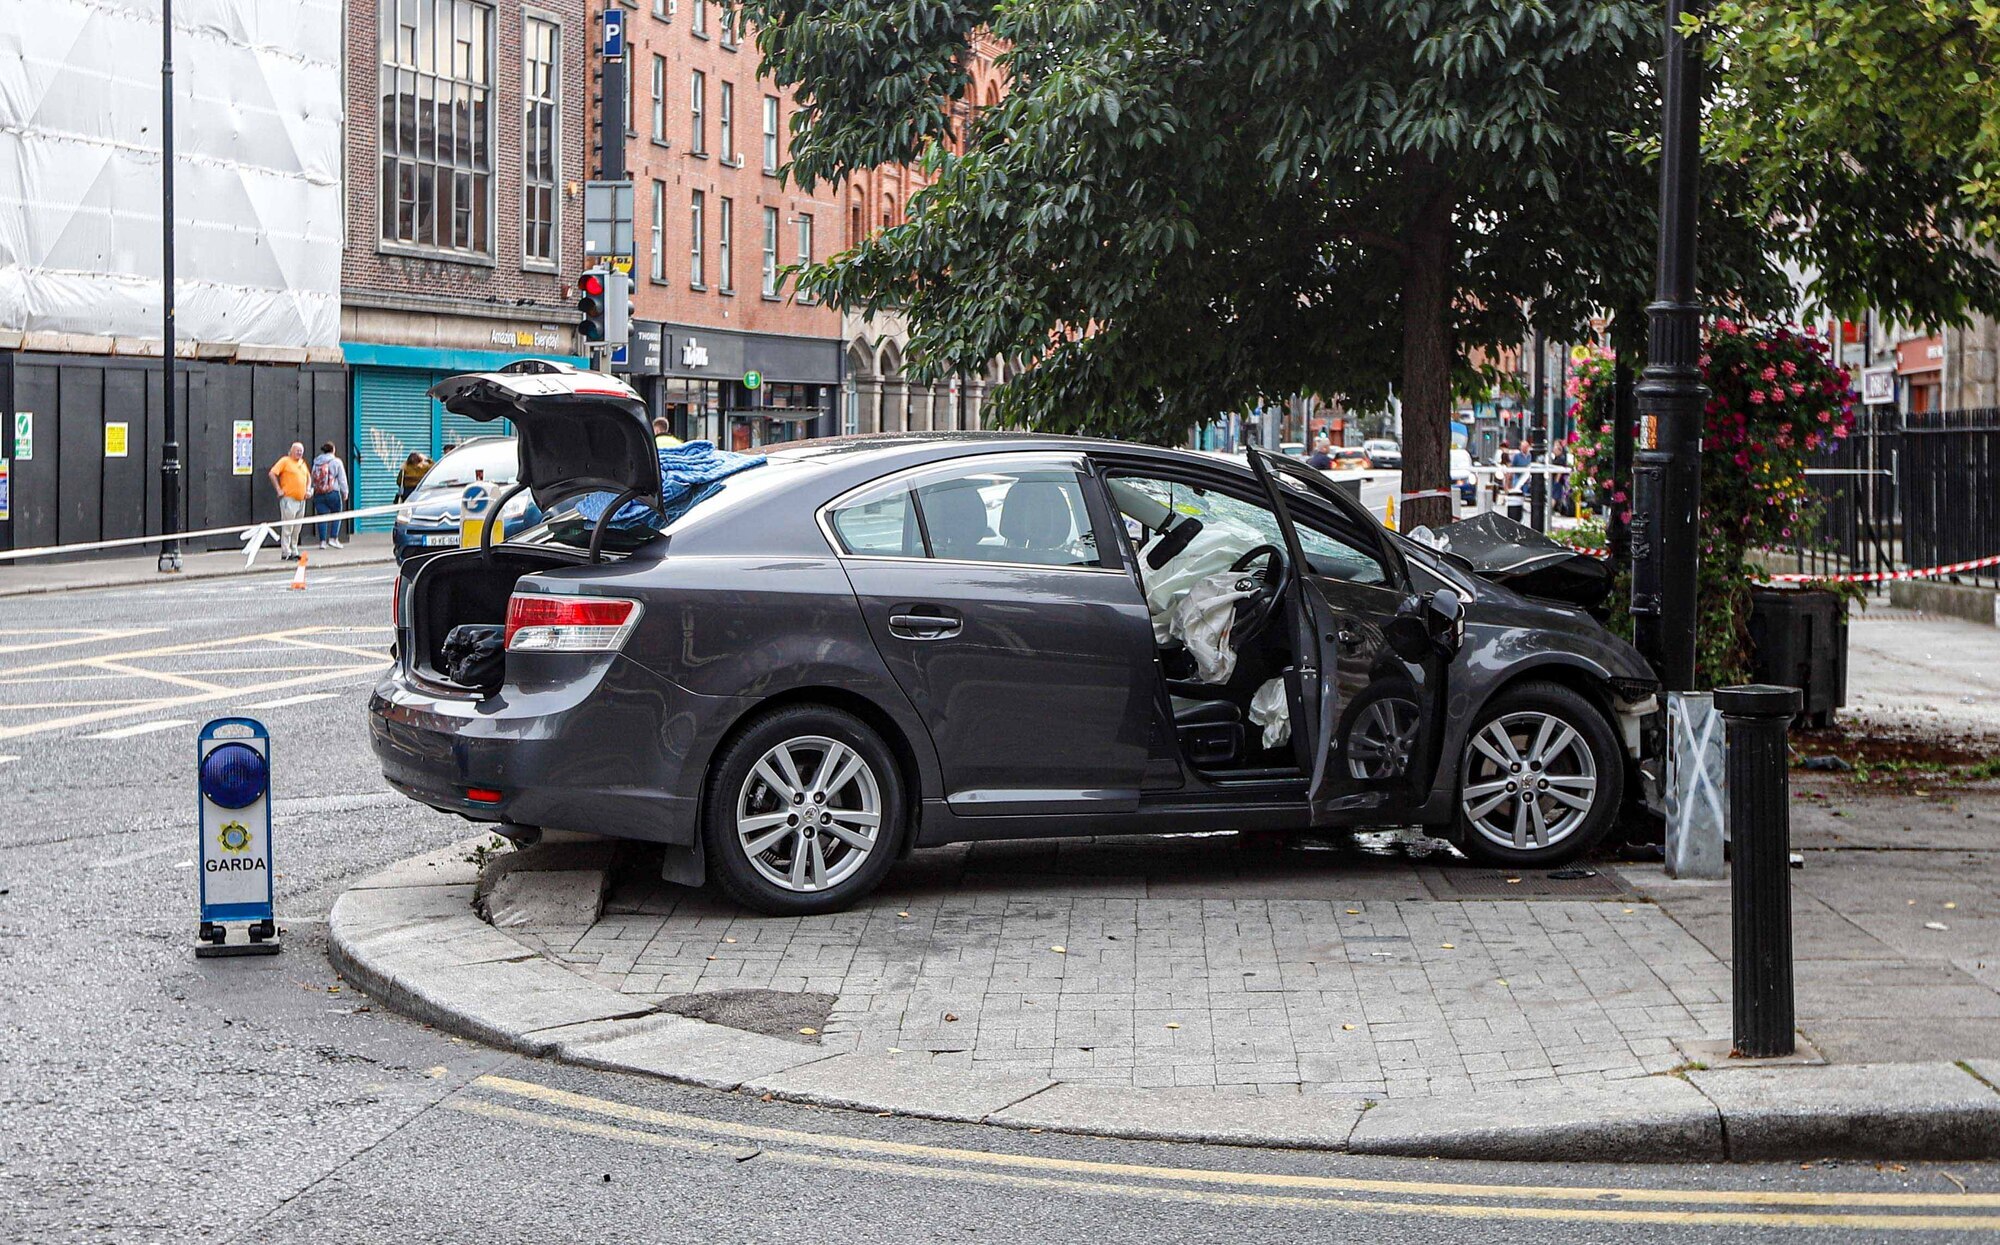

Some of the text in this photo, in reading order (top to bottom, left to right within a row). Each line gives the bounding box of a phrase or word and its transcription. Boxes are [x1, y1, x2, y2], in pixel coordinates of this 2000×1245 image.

[606, 24, 620, 42] P
[491, 329, 560, 350] Amazing Value Everyday!
[205, 857, 266, 872] GARDA
